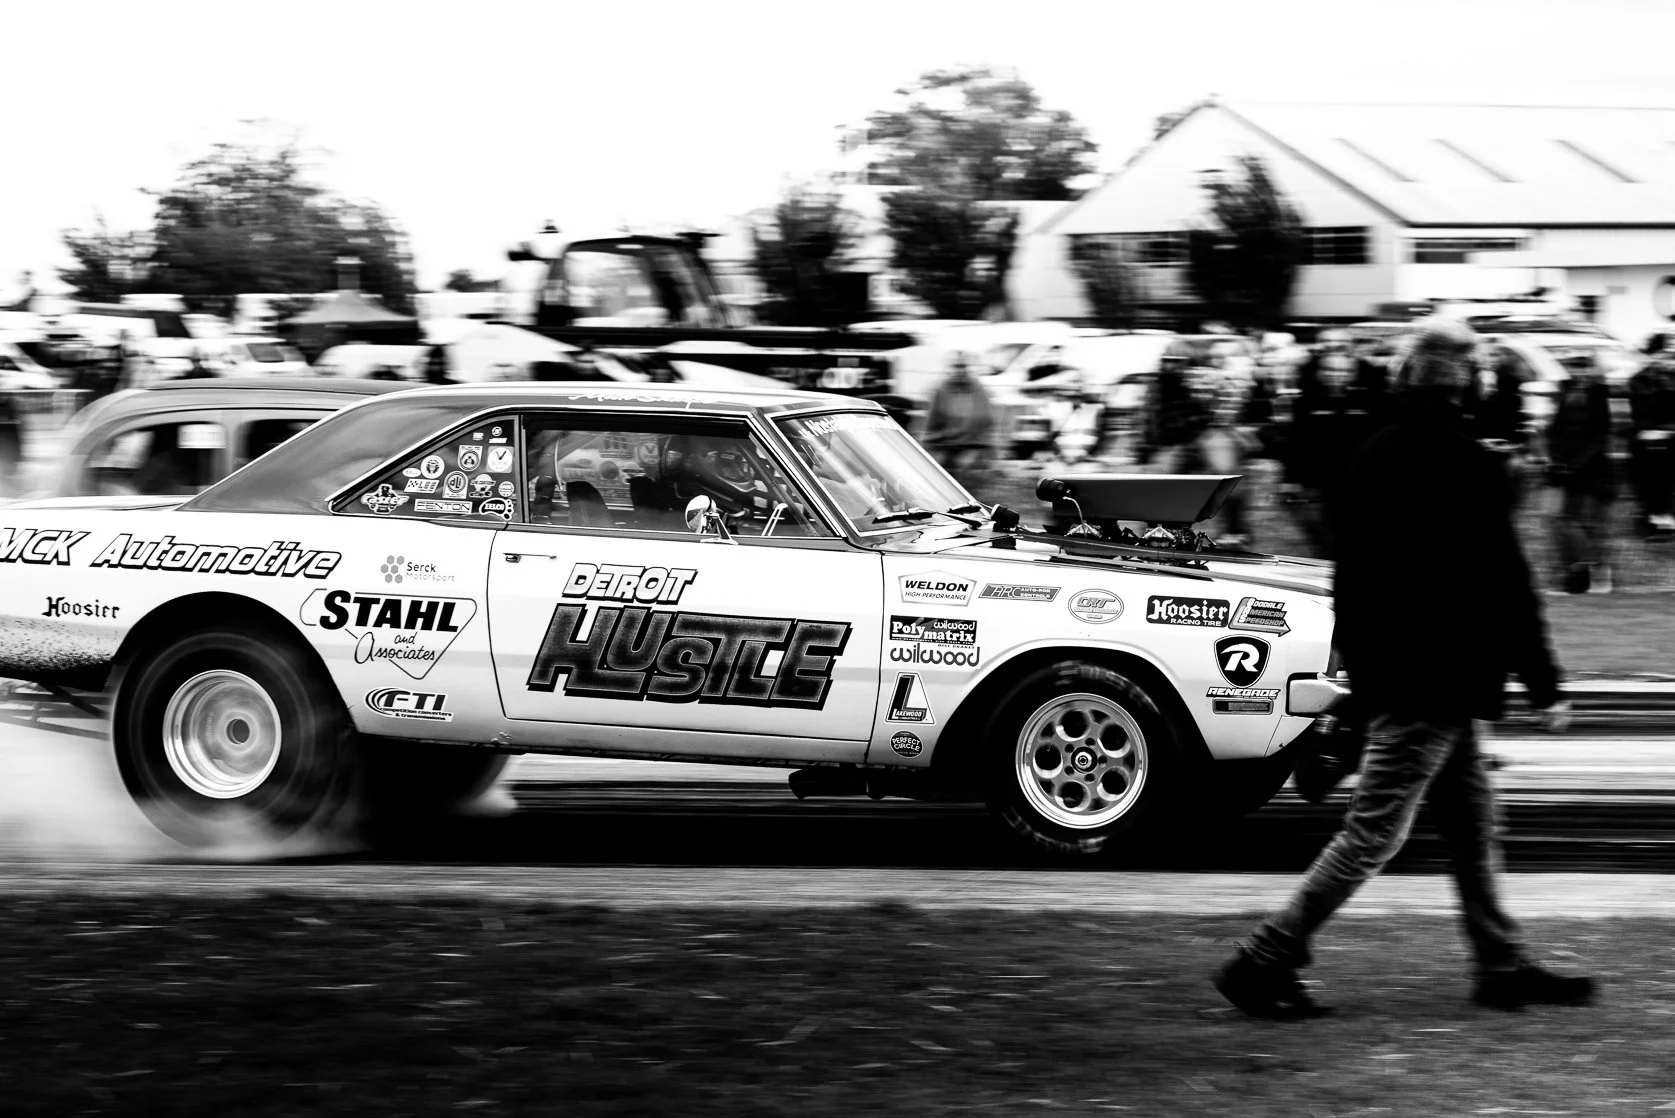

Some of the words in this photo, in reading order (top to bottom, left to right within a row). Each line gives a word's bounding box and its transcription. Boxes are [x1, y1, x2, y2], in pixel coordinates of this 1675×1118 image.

[417, 481, 438, 490] LEE
[416, 501, 472, 513] FENTON
[89, 533, 342, 580] Automotive
[406, 561, 437, 573] Serck
[406, 572, 455, 582] Motorsport
[562, 562, 698, 605] DETROIT
[904, 580, 969, 592] WELDON
[921, 591, 967, 600] PERFORMANCE
[41, 596, 120, 619] Hoosier
[319, 589, 459, 633] STAHL
[1147, 598, 1229, 621] Hoosier
[933, 620, 976, 631] wilwood
[1170, 618, 1201, 626] RACING
[1202, 619, 1223, 627] TIRE
[394, 632, 418, 645] and
[354, 631, 436, 665] Associates
[526, 603, 852, 711] HUSTLE
[889, 642, 981, 667] wilwood
[1207, 687, 1280, 698] RENEGADE
[377, 690, 446, 711] FTI
[891, 708, 923, 719] LAKEWOOD
[891, 736, 921, 746] PERFECT
[893, 743, 921, 752] CIRCLE
